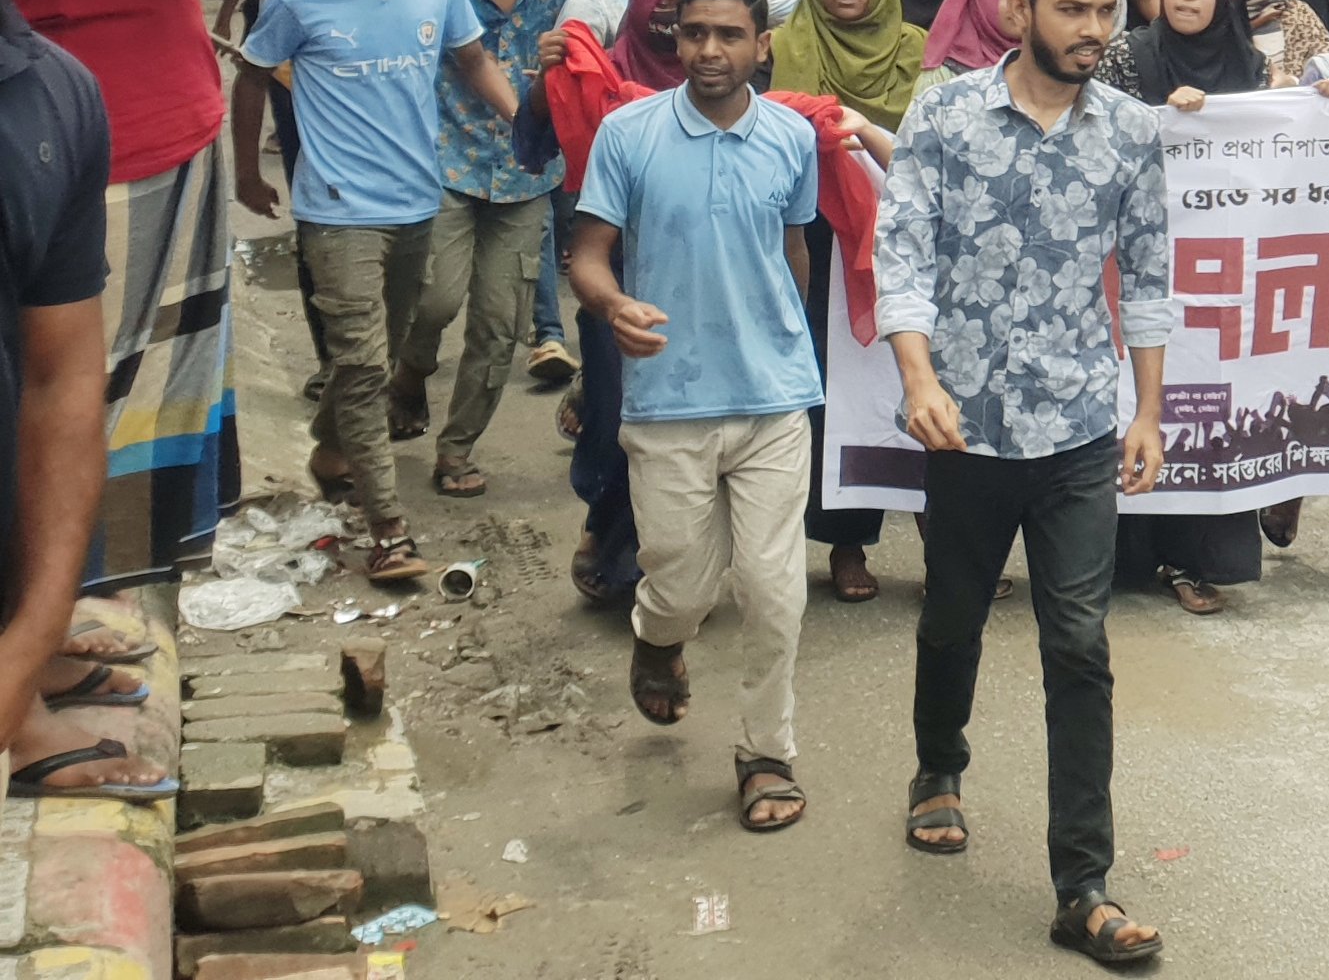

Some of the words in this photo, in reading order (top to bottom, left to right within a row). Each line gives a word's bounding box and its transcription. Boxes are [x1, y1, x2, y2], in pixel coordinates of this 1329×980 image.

[1222, 139, 1264, 160] প্রথা
[1182, 188, 1249, 211] গ্রেডে
[1261, 187, 1298, 206] সব
